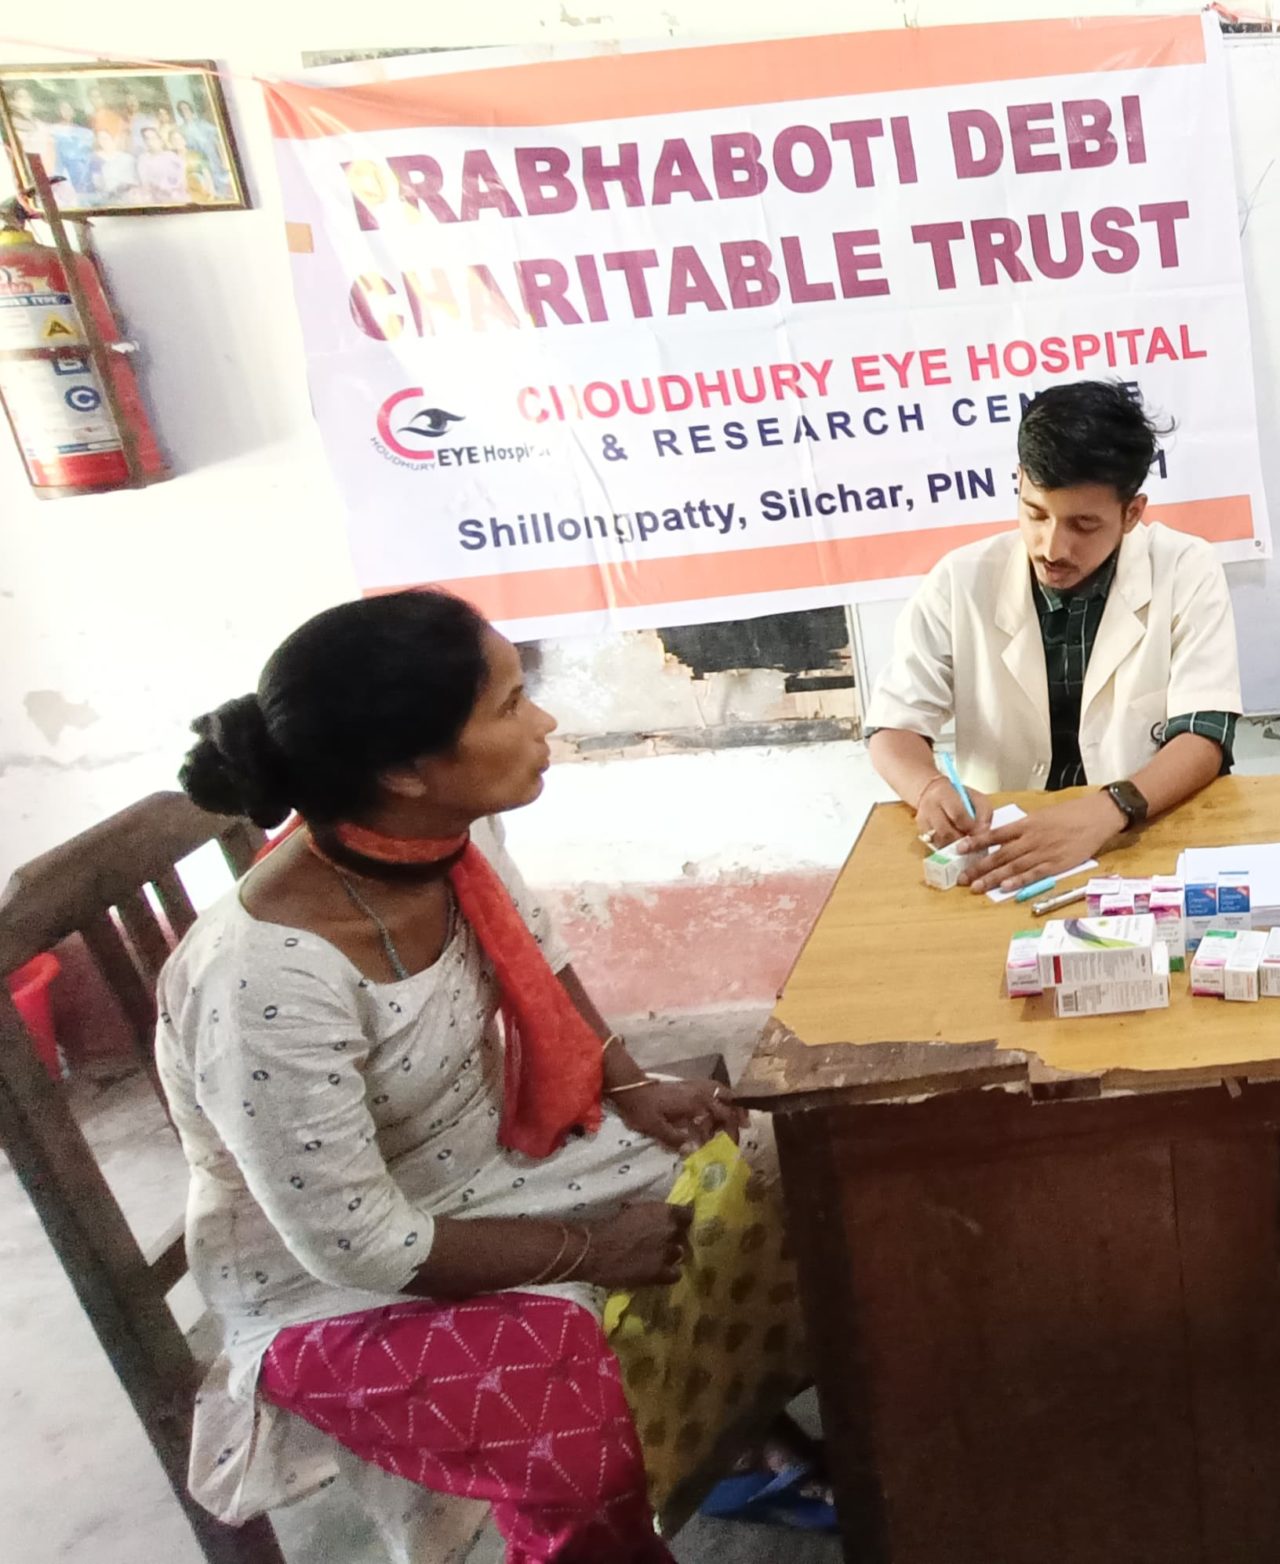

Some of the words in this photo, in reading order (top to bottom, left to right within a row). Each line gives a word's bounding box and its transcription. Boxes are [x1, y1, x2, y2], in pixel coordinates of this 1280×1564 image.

[340, 116, 918, 231] PRABHABOTI
[948, 95, 1147, 179] DEBI
[349, 229, 891, 341] CHARITABLE
[911, 200, 1190, 290] TRUST
[517, 359, 834, 423] CHOUDHURY
[852, 348, 951, 393] EYE
[966, 324, 1208, 381] HOSPITAL
[437, 446, 480, 467] EYE
[602, 434, 628, 462] &
[653, 403, 925, 458] RESEARCH
[760, 484, 914, 522] Silchar,
[927, 468, 997, 503] PIN
